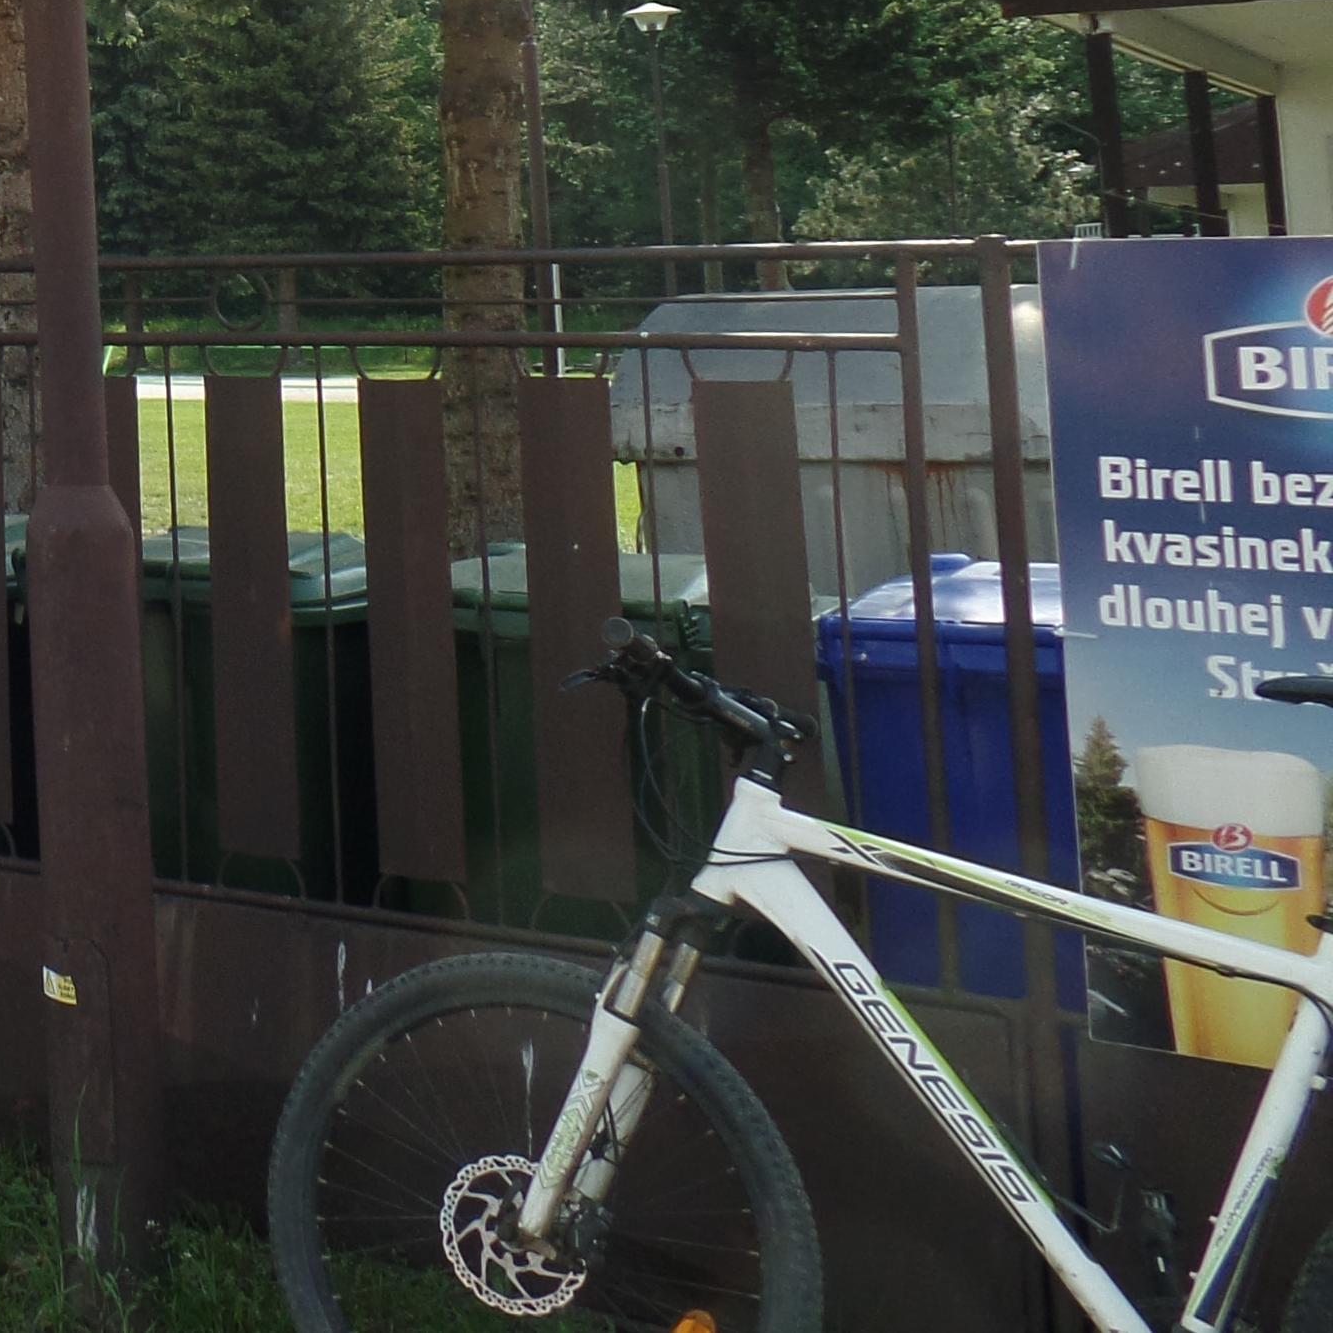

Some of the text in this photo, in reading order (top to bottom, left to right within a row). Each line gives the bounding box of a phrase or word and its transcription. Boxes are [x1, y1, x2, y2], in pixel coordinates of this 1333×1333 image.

[1098, 456, 1232, 503] Birell
[1103, 519, 1333, 573] kvasinek
[1099, 584, 1286, 649] dlouhej
[1180, 850, 1288, 882] BIRELL
[833, 962, 1039, 1203] GENESIS
